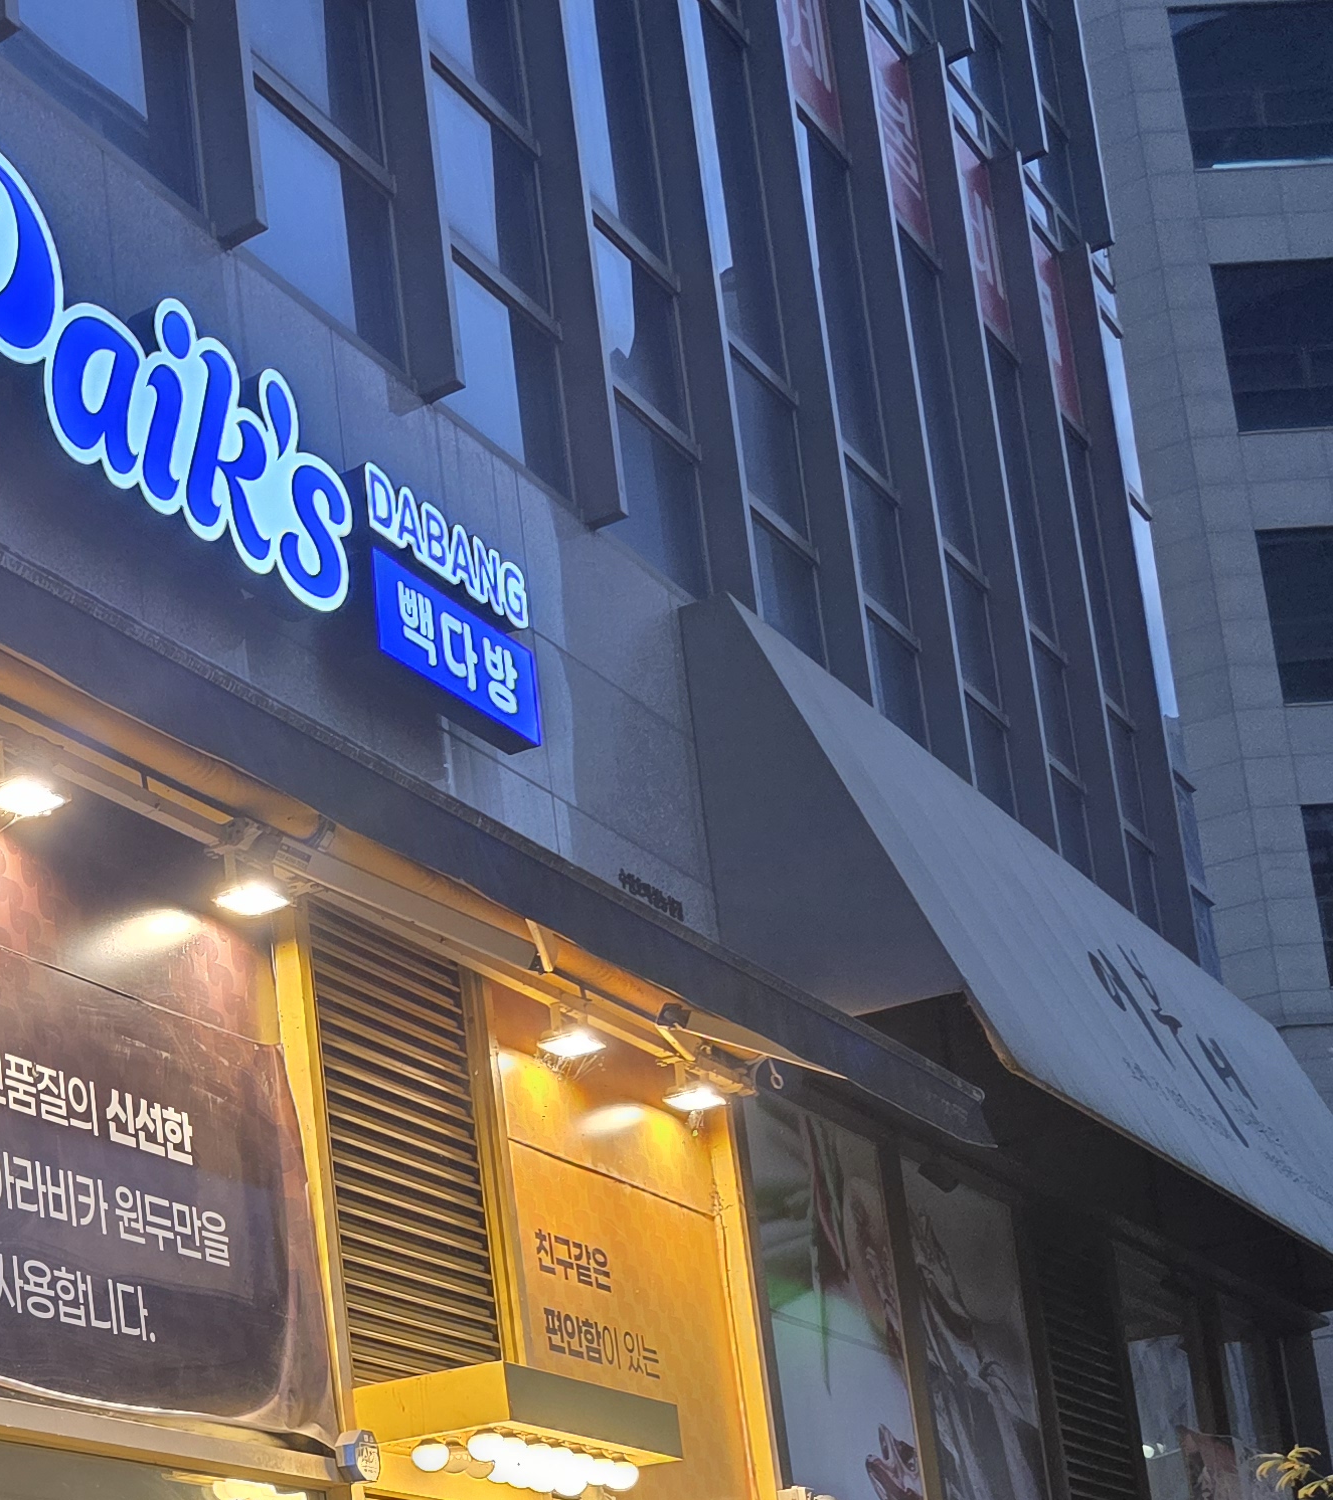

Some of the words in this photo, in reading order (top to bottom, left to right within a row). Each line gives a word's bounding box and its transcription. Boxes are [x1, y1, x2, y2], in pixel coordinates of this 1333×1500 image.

[364, 462, 528, 630] DABANG
[397, 580, 519, 715] 빽다방
[105, 1088, 193, 1166] 신선한
[113, 1184, 232, 1267] 원두만을
[535, 1227, 612, 1293] 친구같은
[544, 1306, 621, 1372] 편안함이
[623, 1329, 662, 1380] 있는
